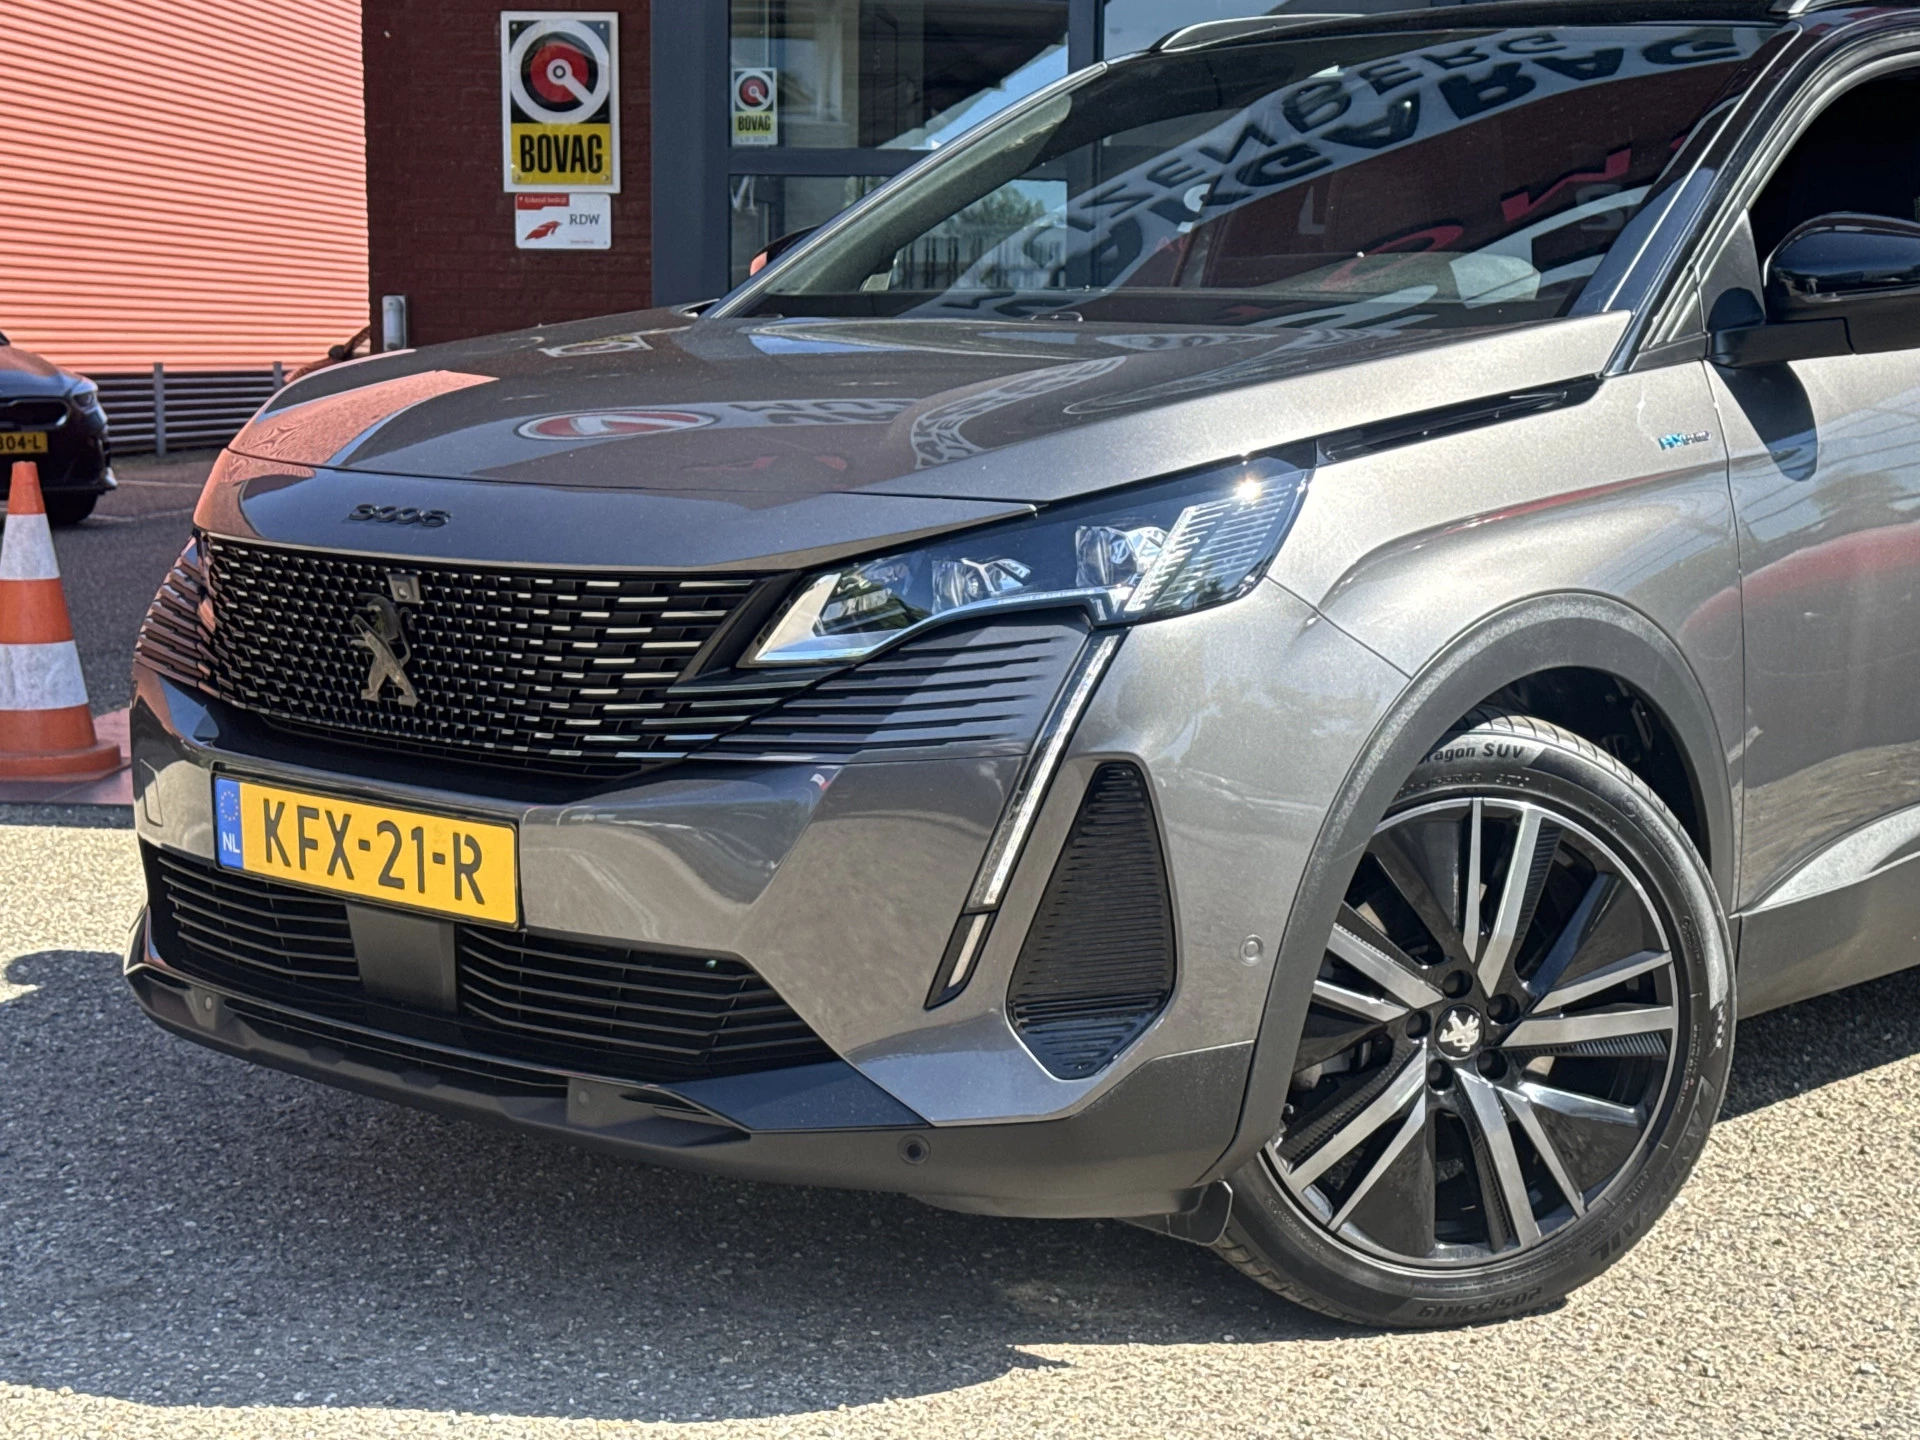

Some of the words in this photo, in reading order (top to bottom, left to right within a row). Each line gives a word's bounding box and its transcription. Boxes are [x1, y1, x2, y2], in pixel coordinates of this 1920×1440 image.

[738, 115, 771, 131] BOVAG
[520, 134, 603, 174] BOVAG
[569, 214, 600, 225] RDW
[1482, 742, 1526, 759] SUV
[222, 831, 240, 854] NL
[263, 797, 486, 906] KFX-21-R
